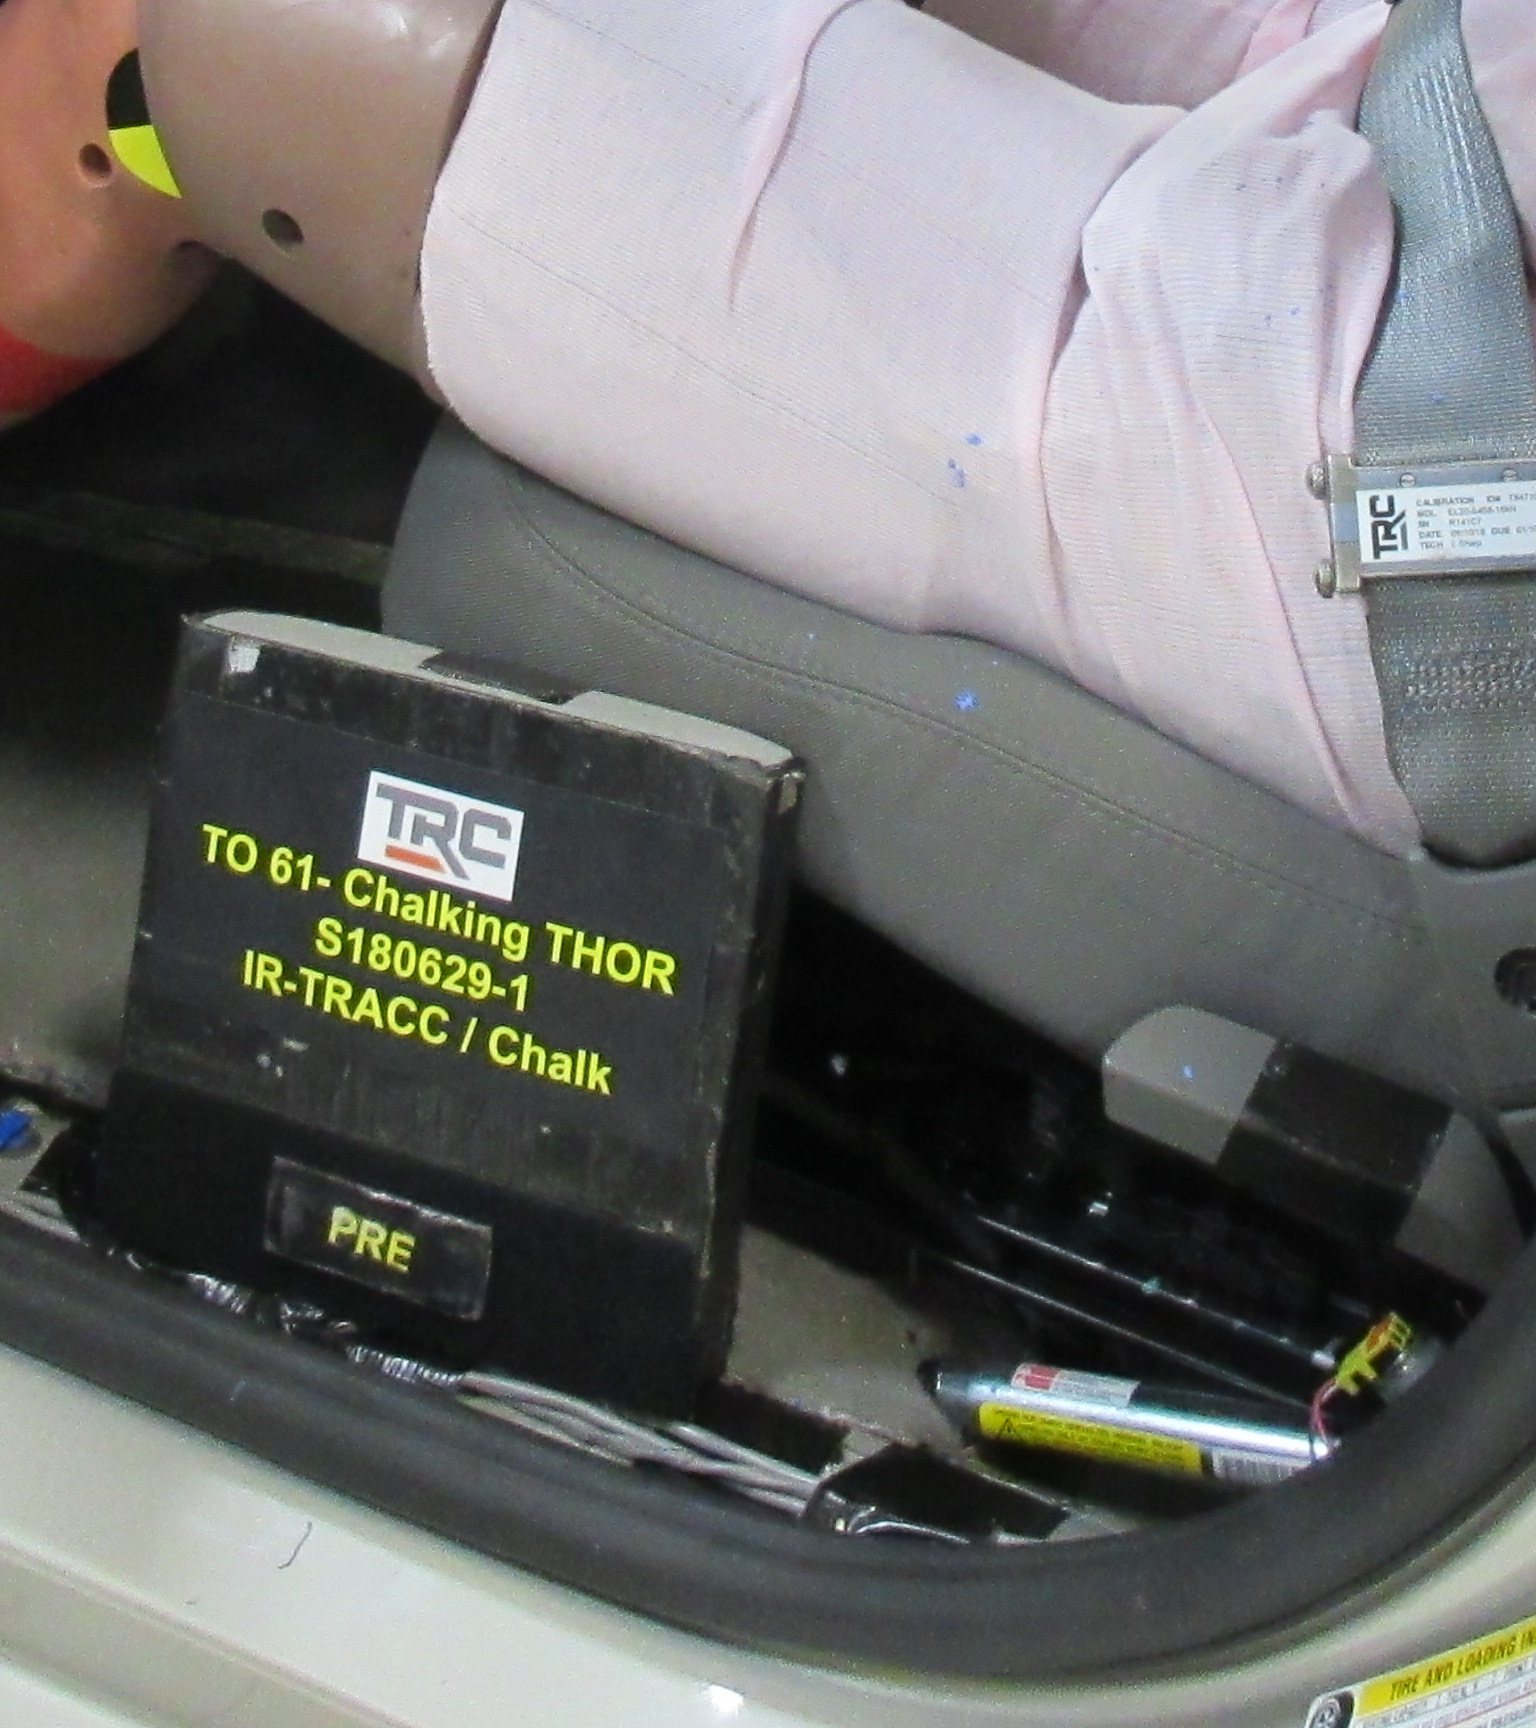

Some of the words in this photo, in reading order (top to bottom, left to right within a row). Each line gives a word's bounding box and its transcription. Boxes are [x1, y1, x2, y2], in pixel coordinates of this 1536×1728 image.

[1369, 494, 1406, 560] TRC
[1416, 497, 1475, 507] CALIBRATION
[1418, 530, 1442, 539] DATE
[1420, 541, 1444, 550] TECH
[374, 782, 513, 880] TRC
[202, 823, 258, 873] TO
[270, 845, 332, 893] 61-
[344, 867, 531, 962] Chalking
[546, 922, 677, 994] THOR
[314, 917, 530, 1011] S180629-1
[242, 949, 450, 1046] IR-TRACC
[461, 1017, 478, 1053] /
[487, 1025, 612, 1095] Chalk
[327, 1206, 416, 1273] PRE
[1389, 1674, 1419, 1701] TIRE
[1425, 1661, 1453, 1687] AND
[1456, 1637, 1515, 1672] LOADING
